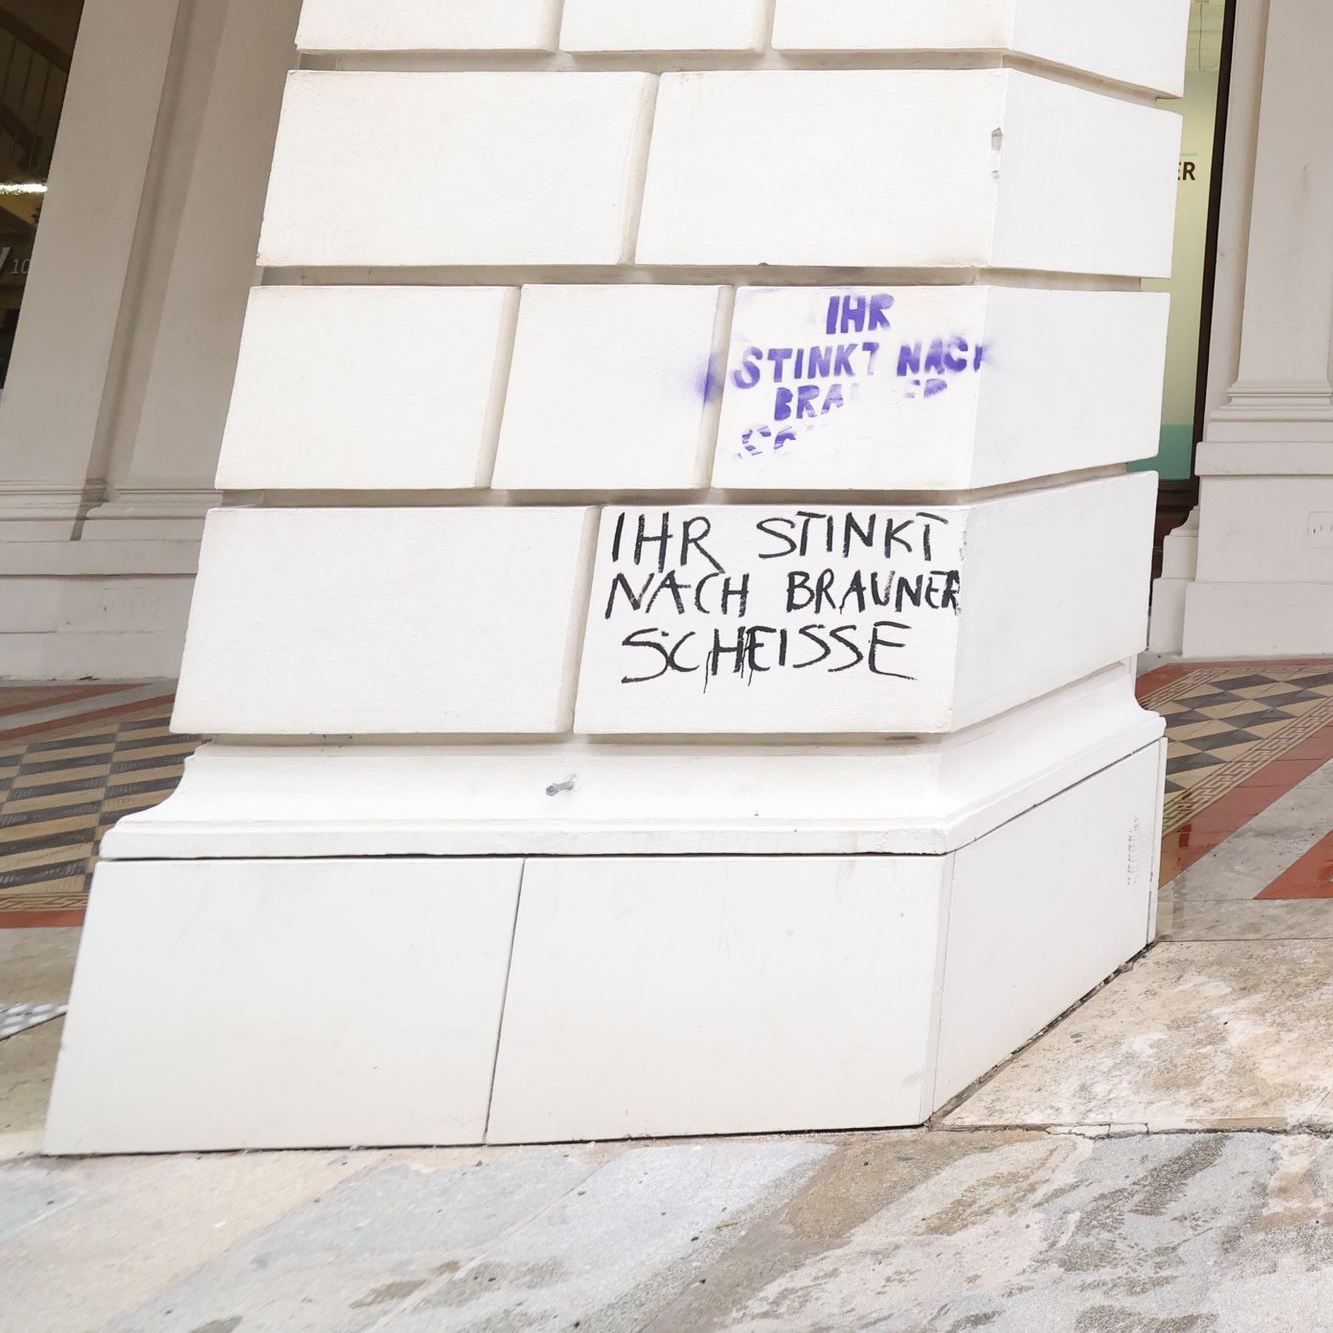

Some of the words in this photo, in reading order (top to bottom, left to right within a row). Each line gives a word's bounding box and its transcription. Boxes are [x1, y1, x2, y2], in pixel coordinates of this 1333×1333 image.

[826, 293, 894, 334] IHR
[732, 341, 880, 389] STINKT
[611, 512, 725, 574] IHR
[756, 511, 950, 562] STINKT
[605, 570, 749, 619] NACH
[785, 569, 961, 616] BRAUNER
[620, 622, 919, 693] SCHEISSE
